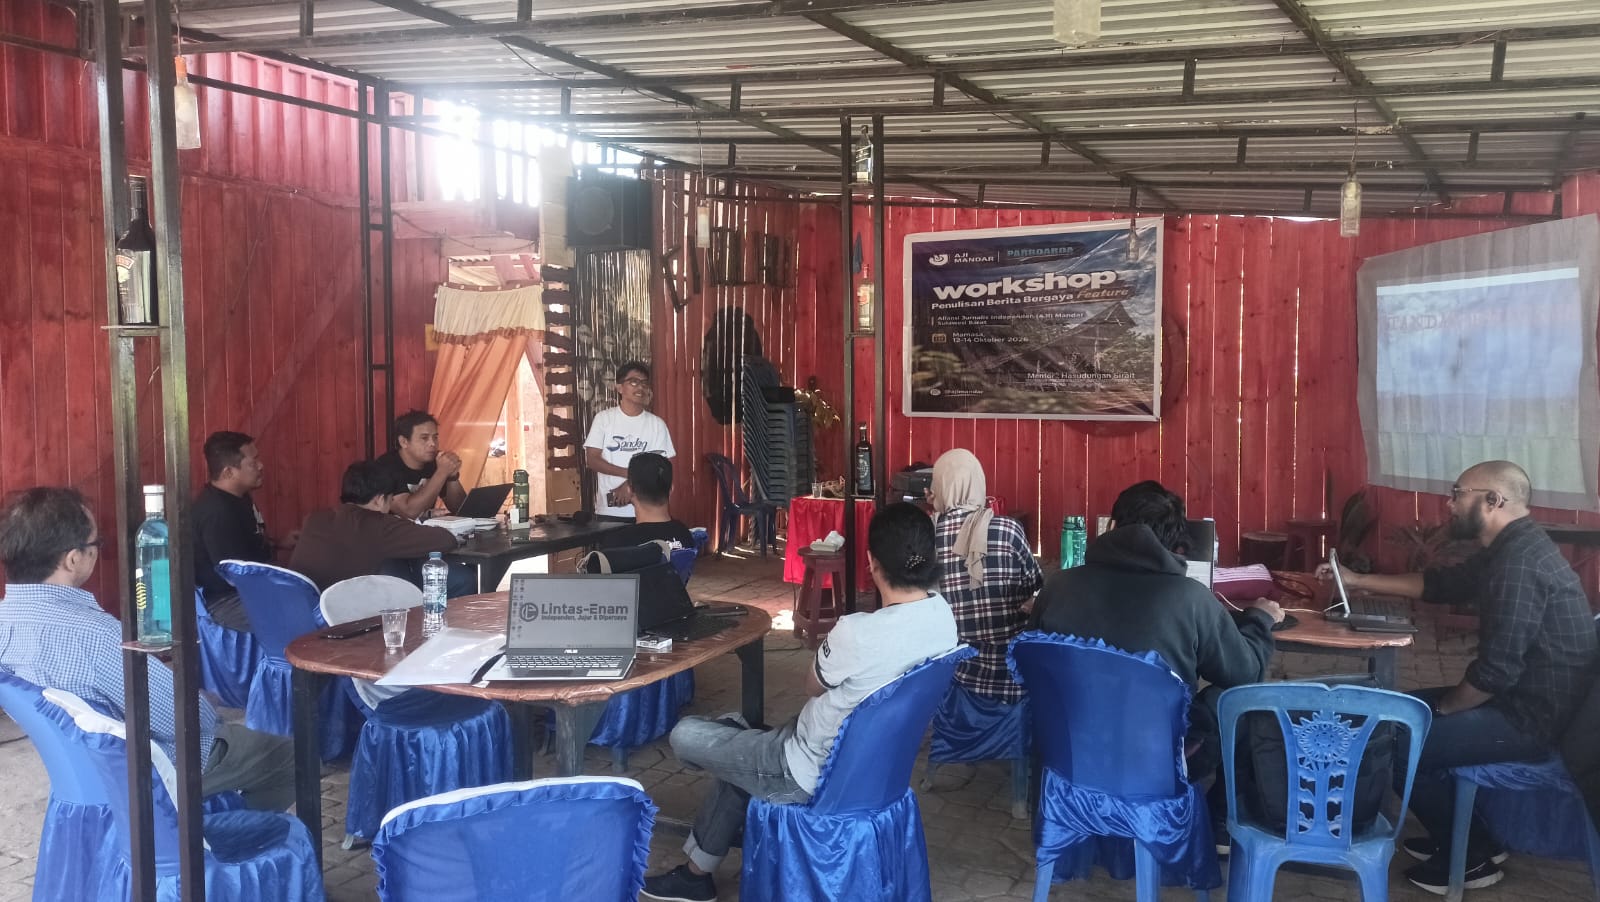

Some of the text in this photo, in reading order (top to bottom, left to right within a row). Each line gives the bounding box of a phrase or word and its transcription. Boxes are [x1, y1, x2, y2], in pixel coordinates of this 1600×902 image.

[932, 269, 1118, 300] workshop
[931, 287, 1129, 310] Penulisan Berita Bergaya Feature
[541, 603, 629, 615] Lintas-Enam
